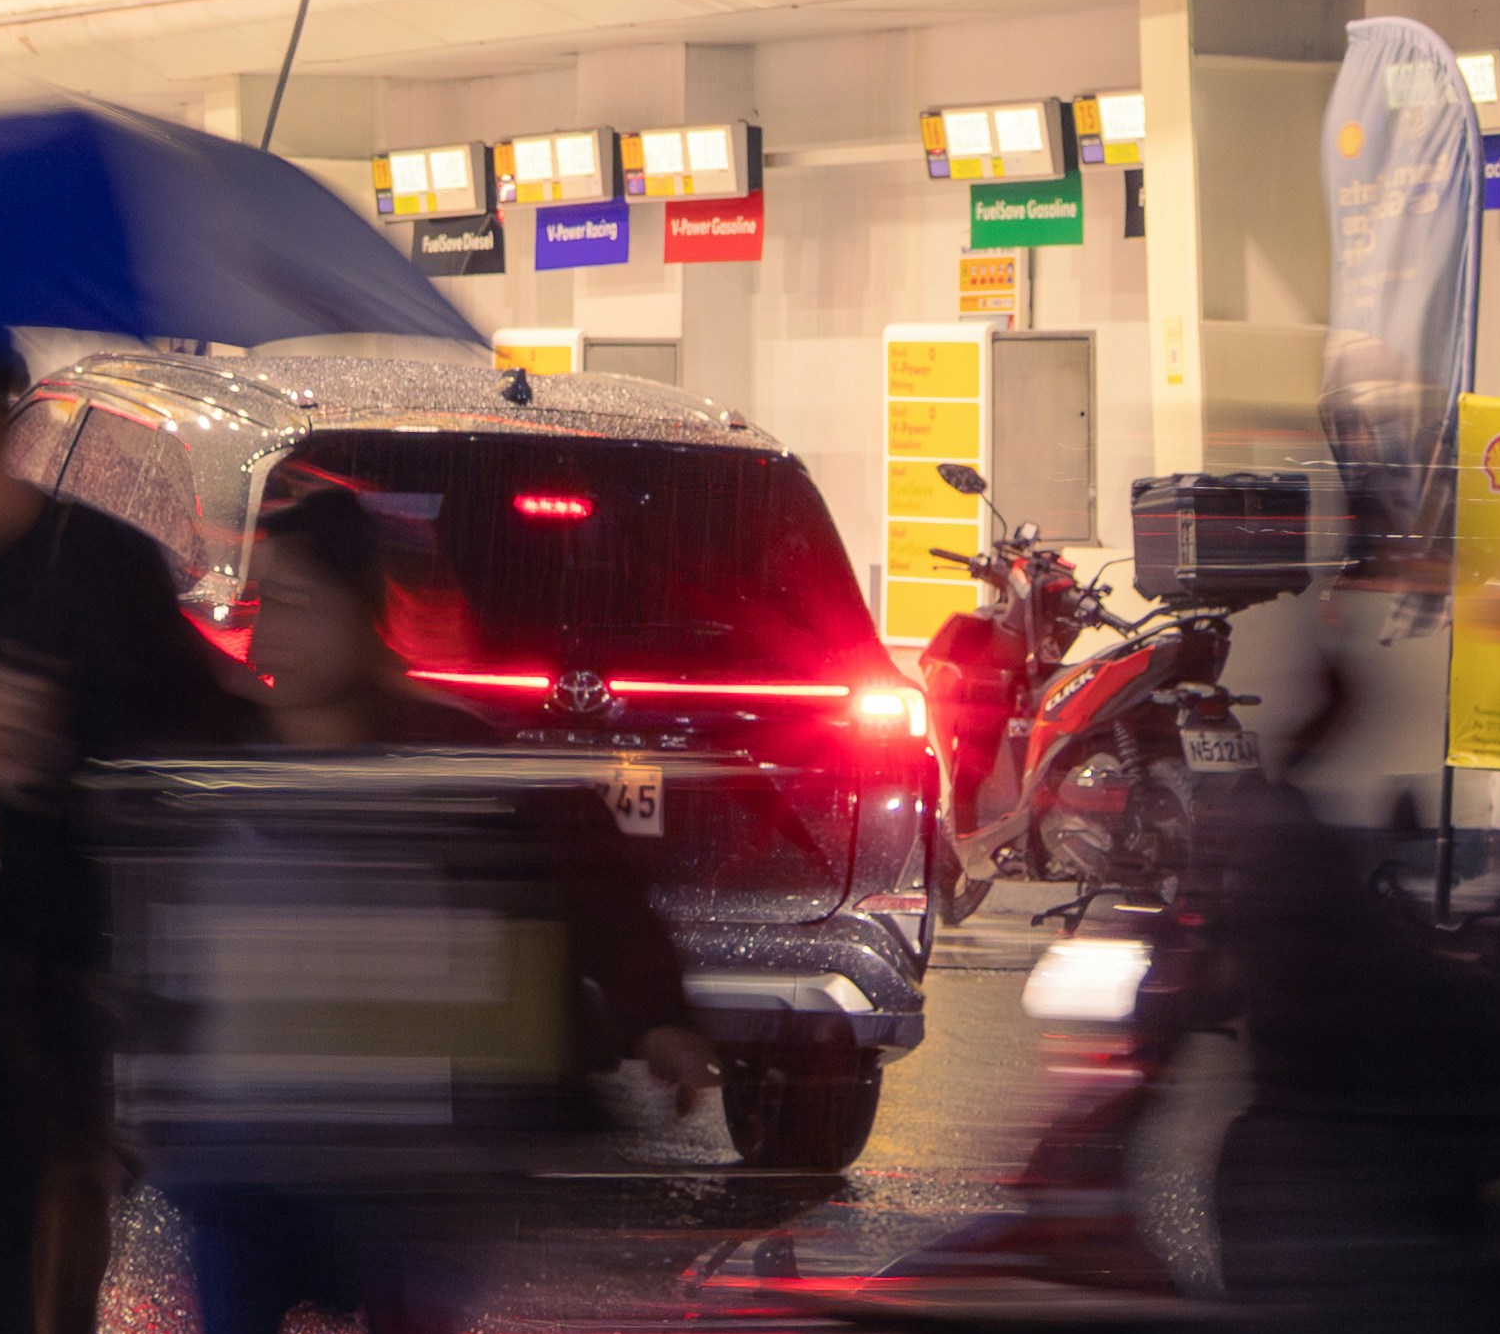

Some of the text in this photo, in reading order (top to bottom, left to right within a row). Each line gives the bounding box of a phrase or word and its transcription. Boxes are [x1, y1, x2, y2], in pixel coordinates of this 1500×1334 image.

[975, 197, 1077, 221] FuelSave Gasoline
[546, 219, 618, 243] V-Power Racing
[671, 216, 757, 237] V-Power Gasoline
[422, 231, 494, 253] FuelSave Diesel
[1044, 668, 1097, 712] CLICK
